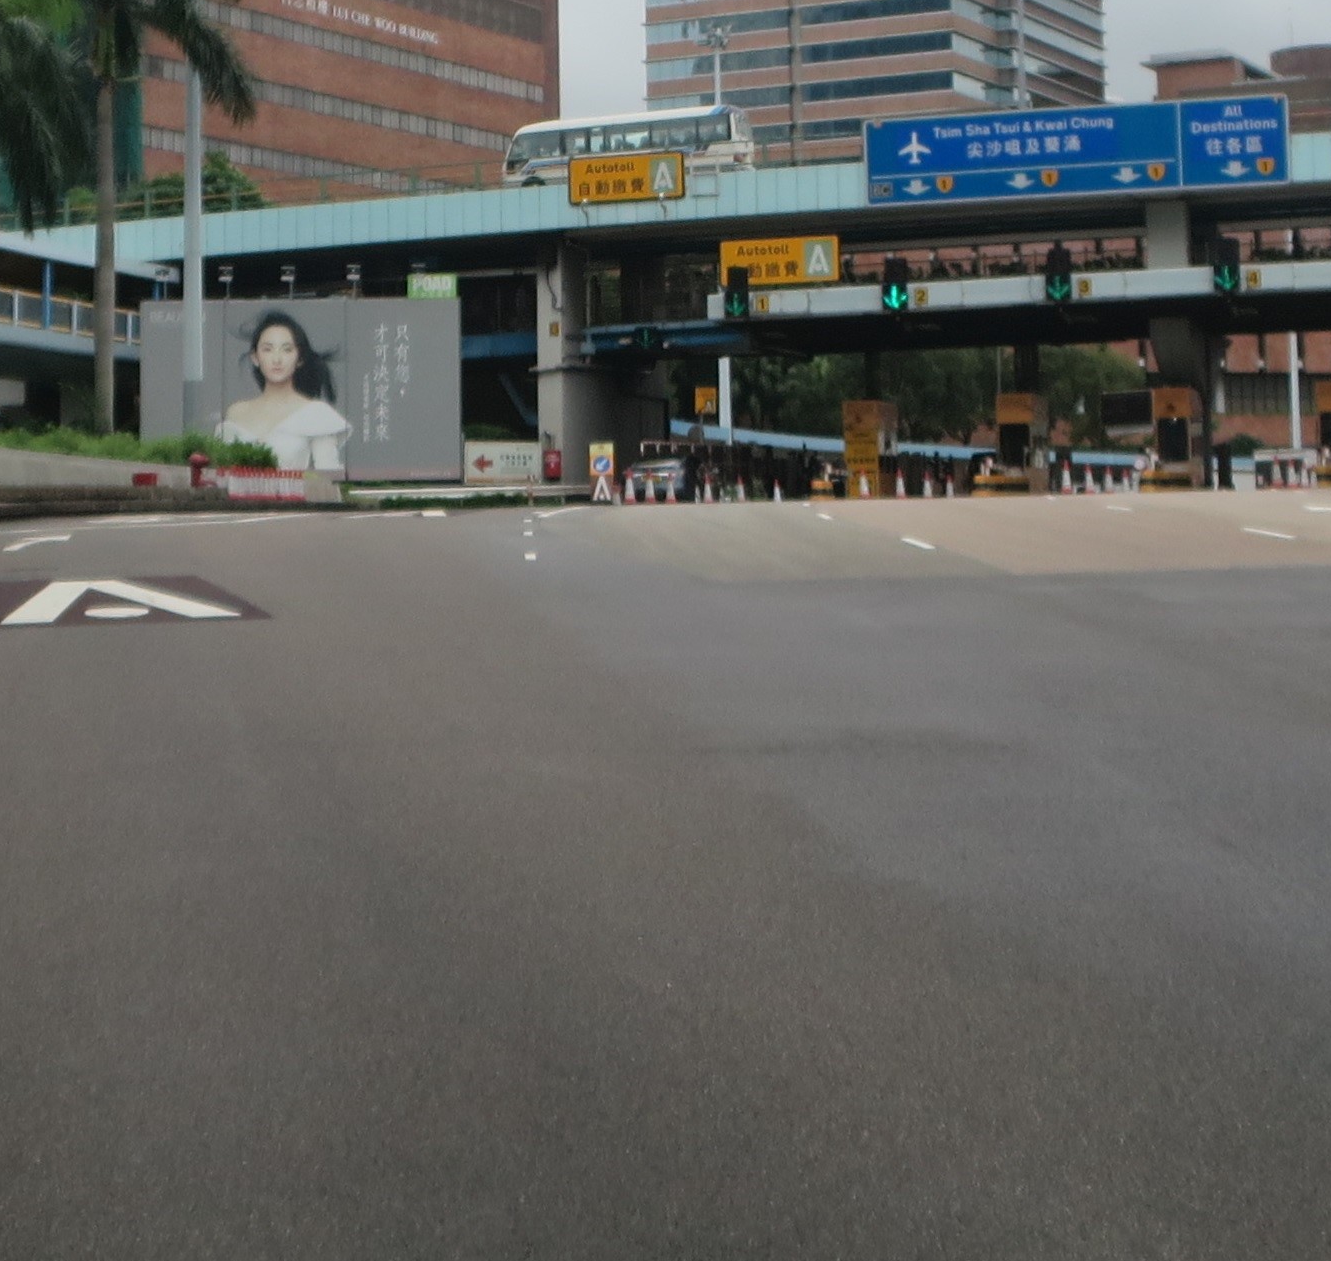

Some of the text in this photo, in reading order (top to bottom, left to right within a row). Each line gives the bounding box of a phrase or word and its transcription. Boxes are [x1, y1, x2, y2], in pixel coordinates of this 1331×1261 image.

[1224, 105, 1242, 117] All
[933, 117, 1114, 139] Tsim Sha Tsui & Kwai Chung
[1190, 119, 1278, 134] Destinations
[585, 162, 635, 175] Autotoll
[736, 244, 789, 257] Autotoll
